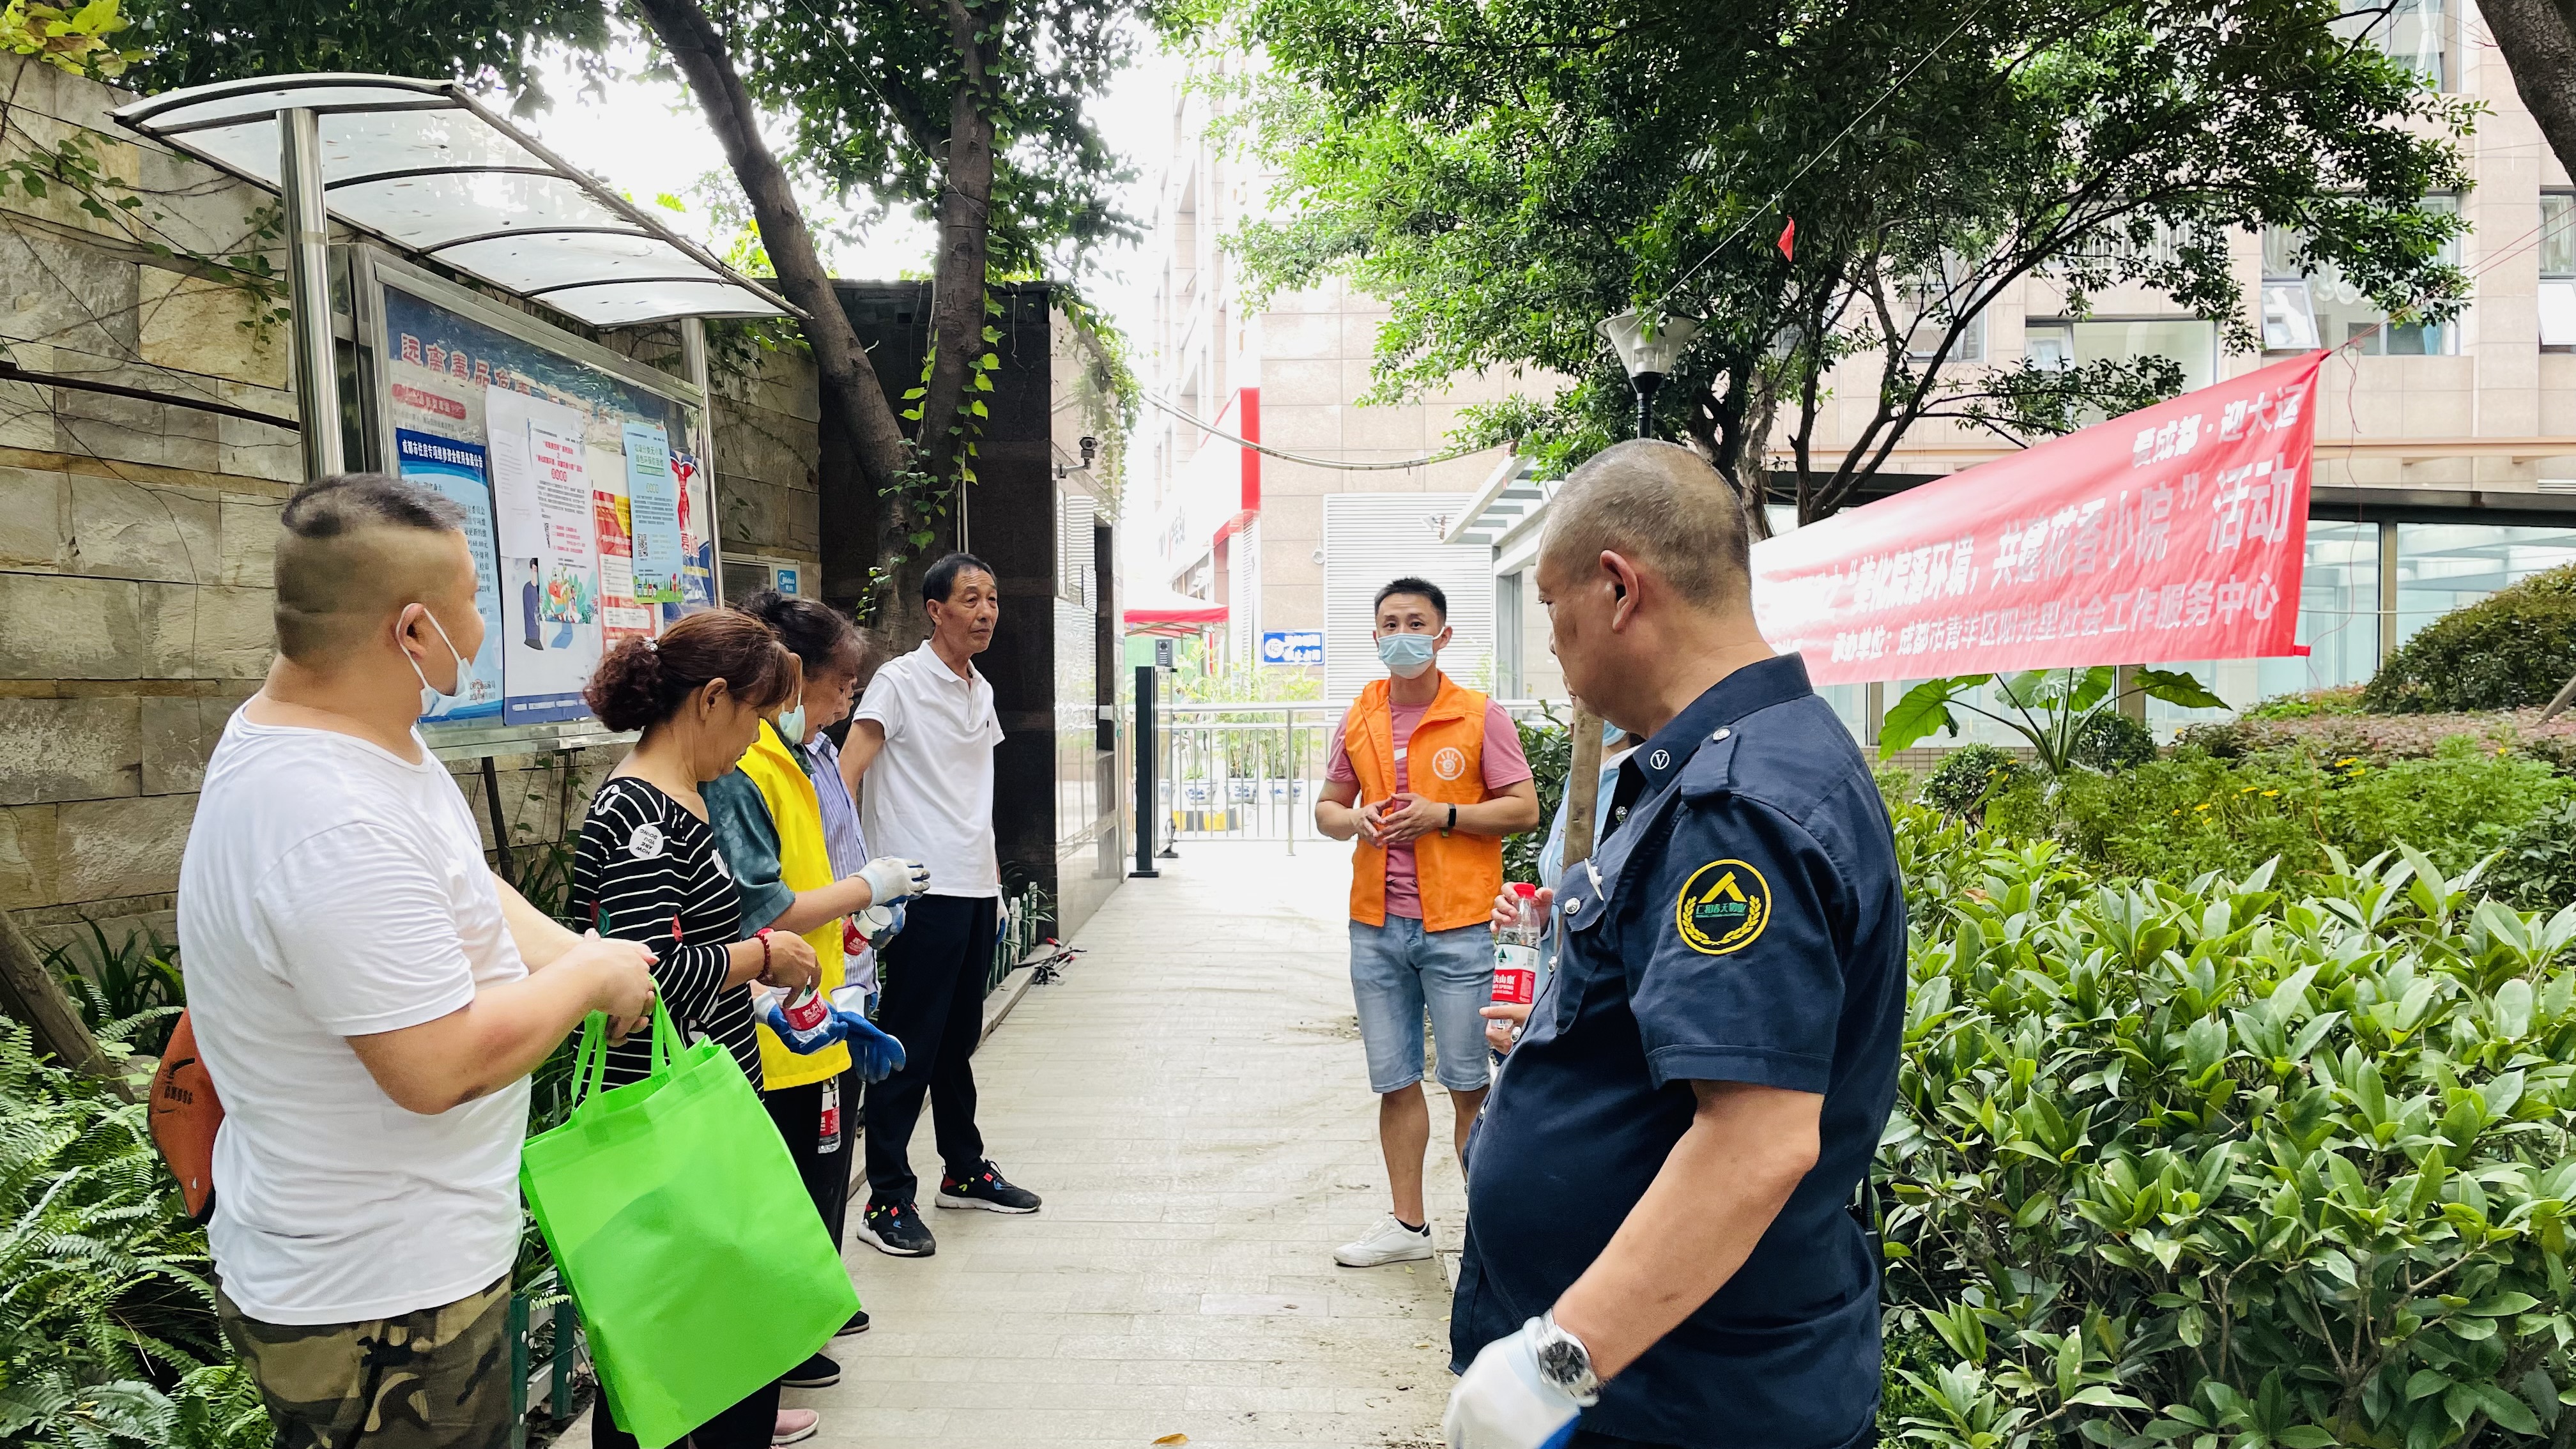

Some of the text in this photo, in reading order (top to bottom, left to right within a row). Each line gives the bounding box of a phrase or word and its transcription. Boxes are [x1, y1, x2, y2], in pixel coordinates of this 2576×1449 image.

[640, 829, 658, 839] DOING
[641, 841, 653, 850] ARE
[635, 846, 650, 855] HOW
